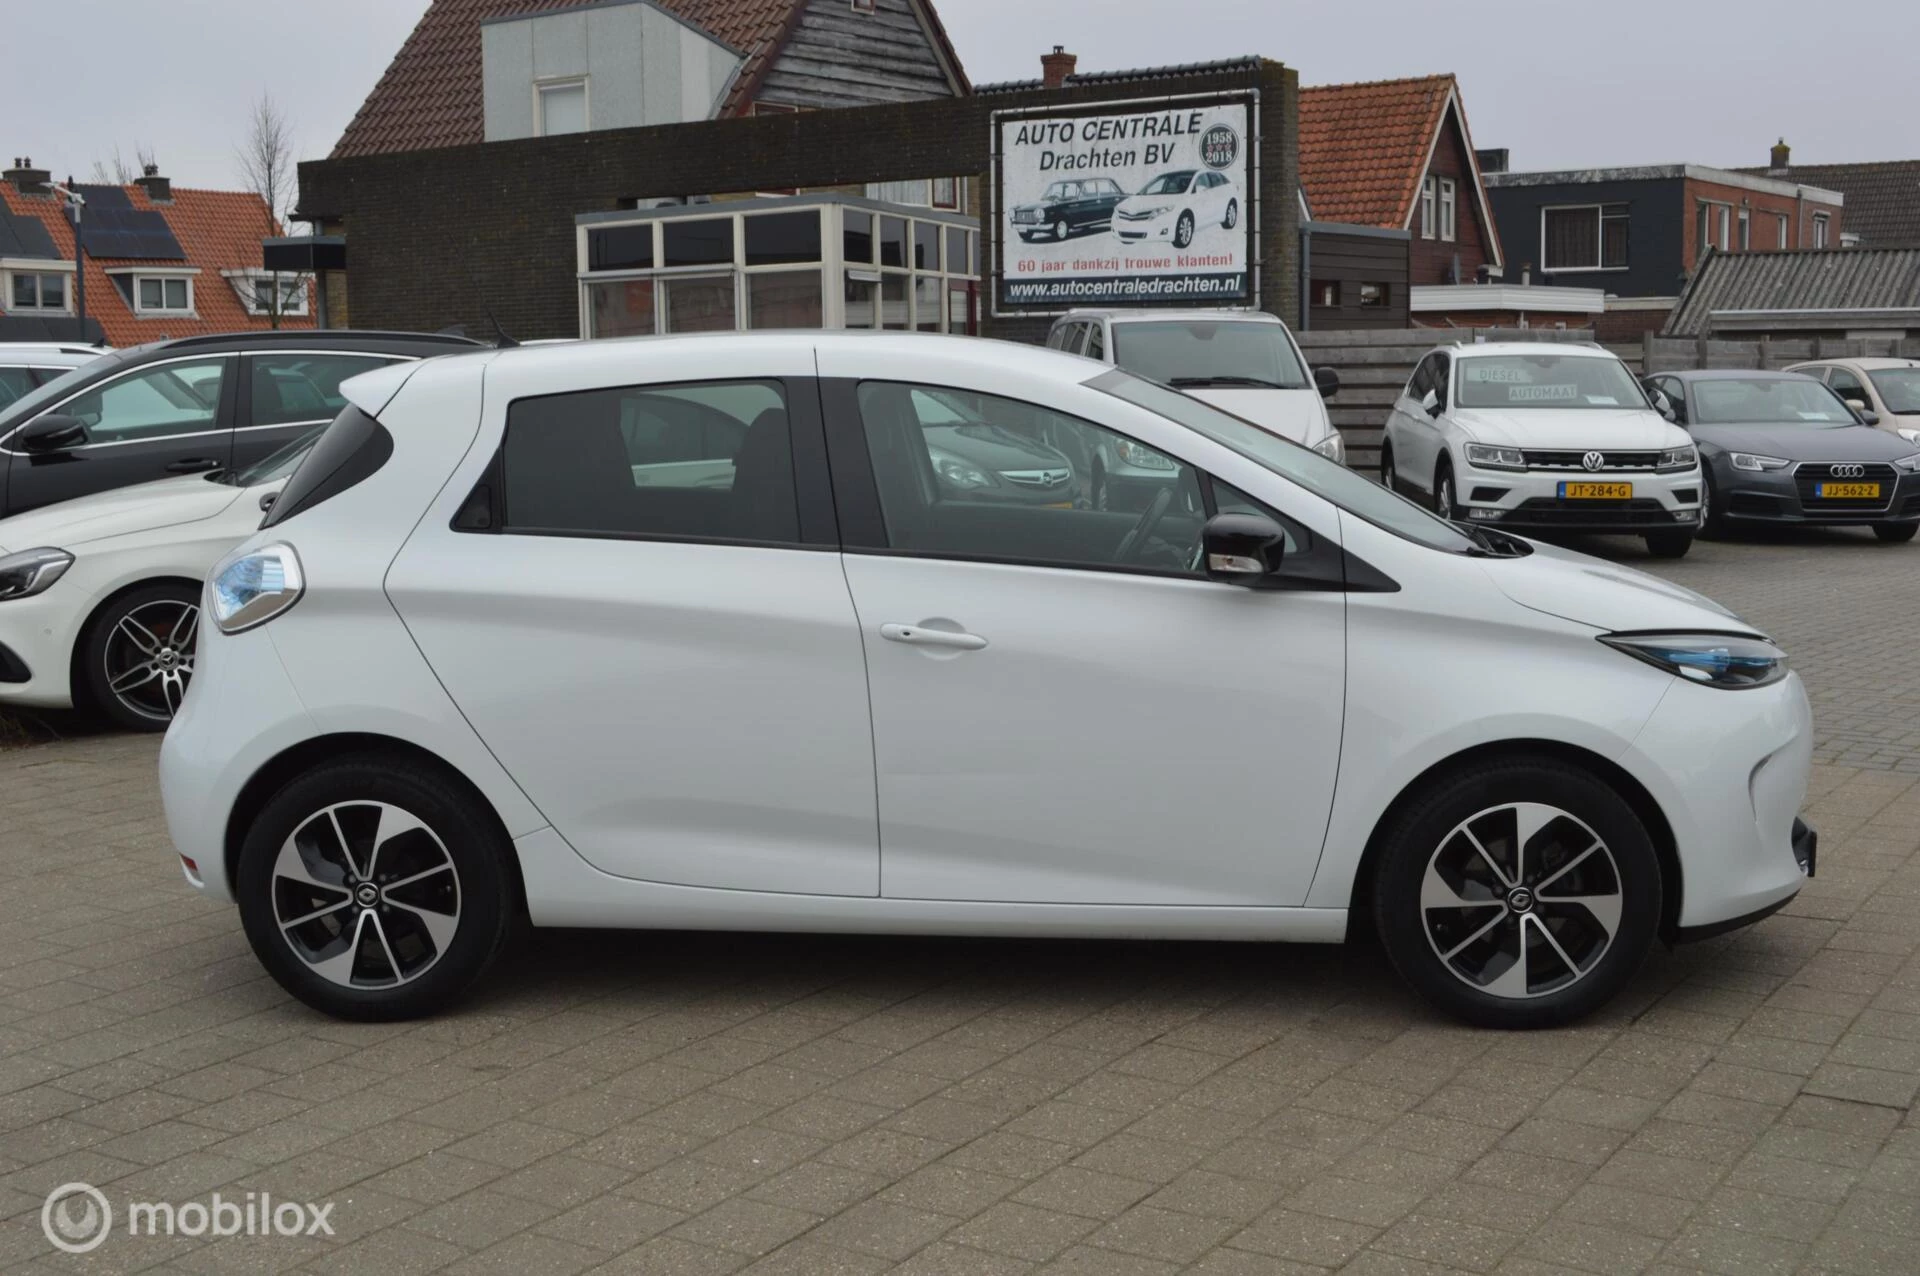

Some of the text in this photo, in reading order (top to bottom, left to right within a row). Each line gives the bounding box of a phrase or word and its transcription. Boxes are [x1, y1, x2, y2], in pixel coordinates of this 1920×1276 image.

[1015, 112, 1203, 146] AUTO CENTRALE
[1206, 131, 1233, 145] 1958
[1039, 142, 1175, 171] Drachten BV
[1206, 150, 1233, 163] 2018
[1018, 252, 1233, 273] 60 jaar dankzij trouwe klanten!
[1010, 275, 1240, 297] www.autocentraledrachten.nl
[1479, 368, 1521, 381] DIESEL
[1570, 484, 1627, 497] JT-284-G
[1826, 485, 1875, 496] JJ-562-Z
